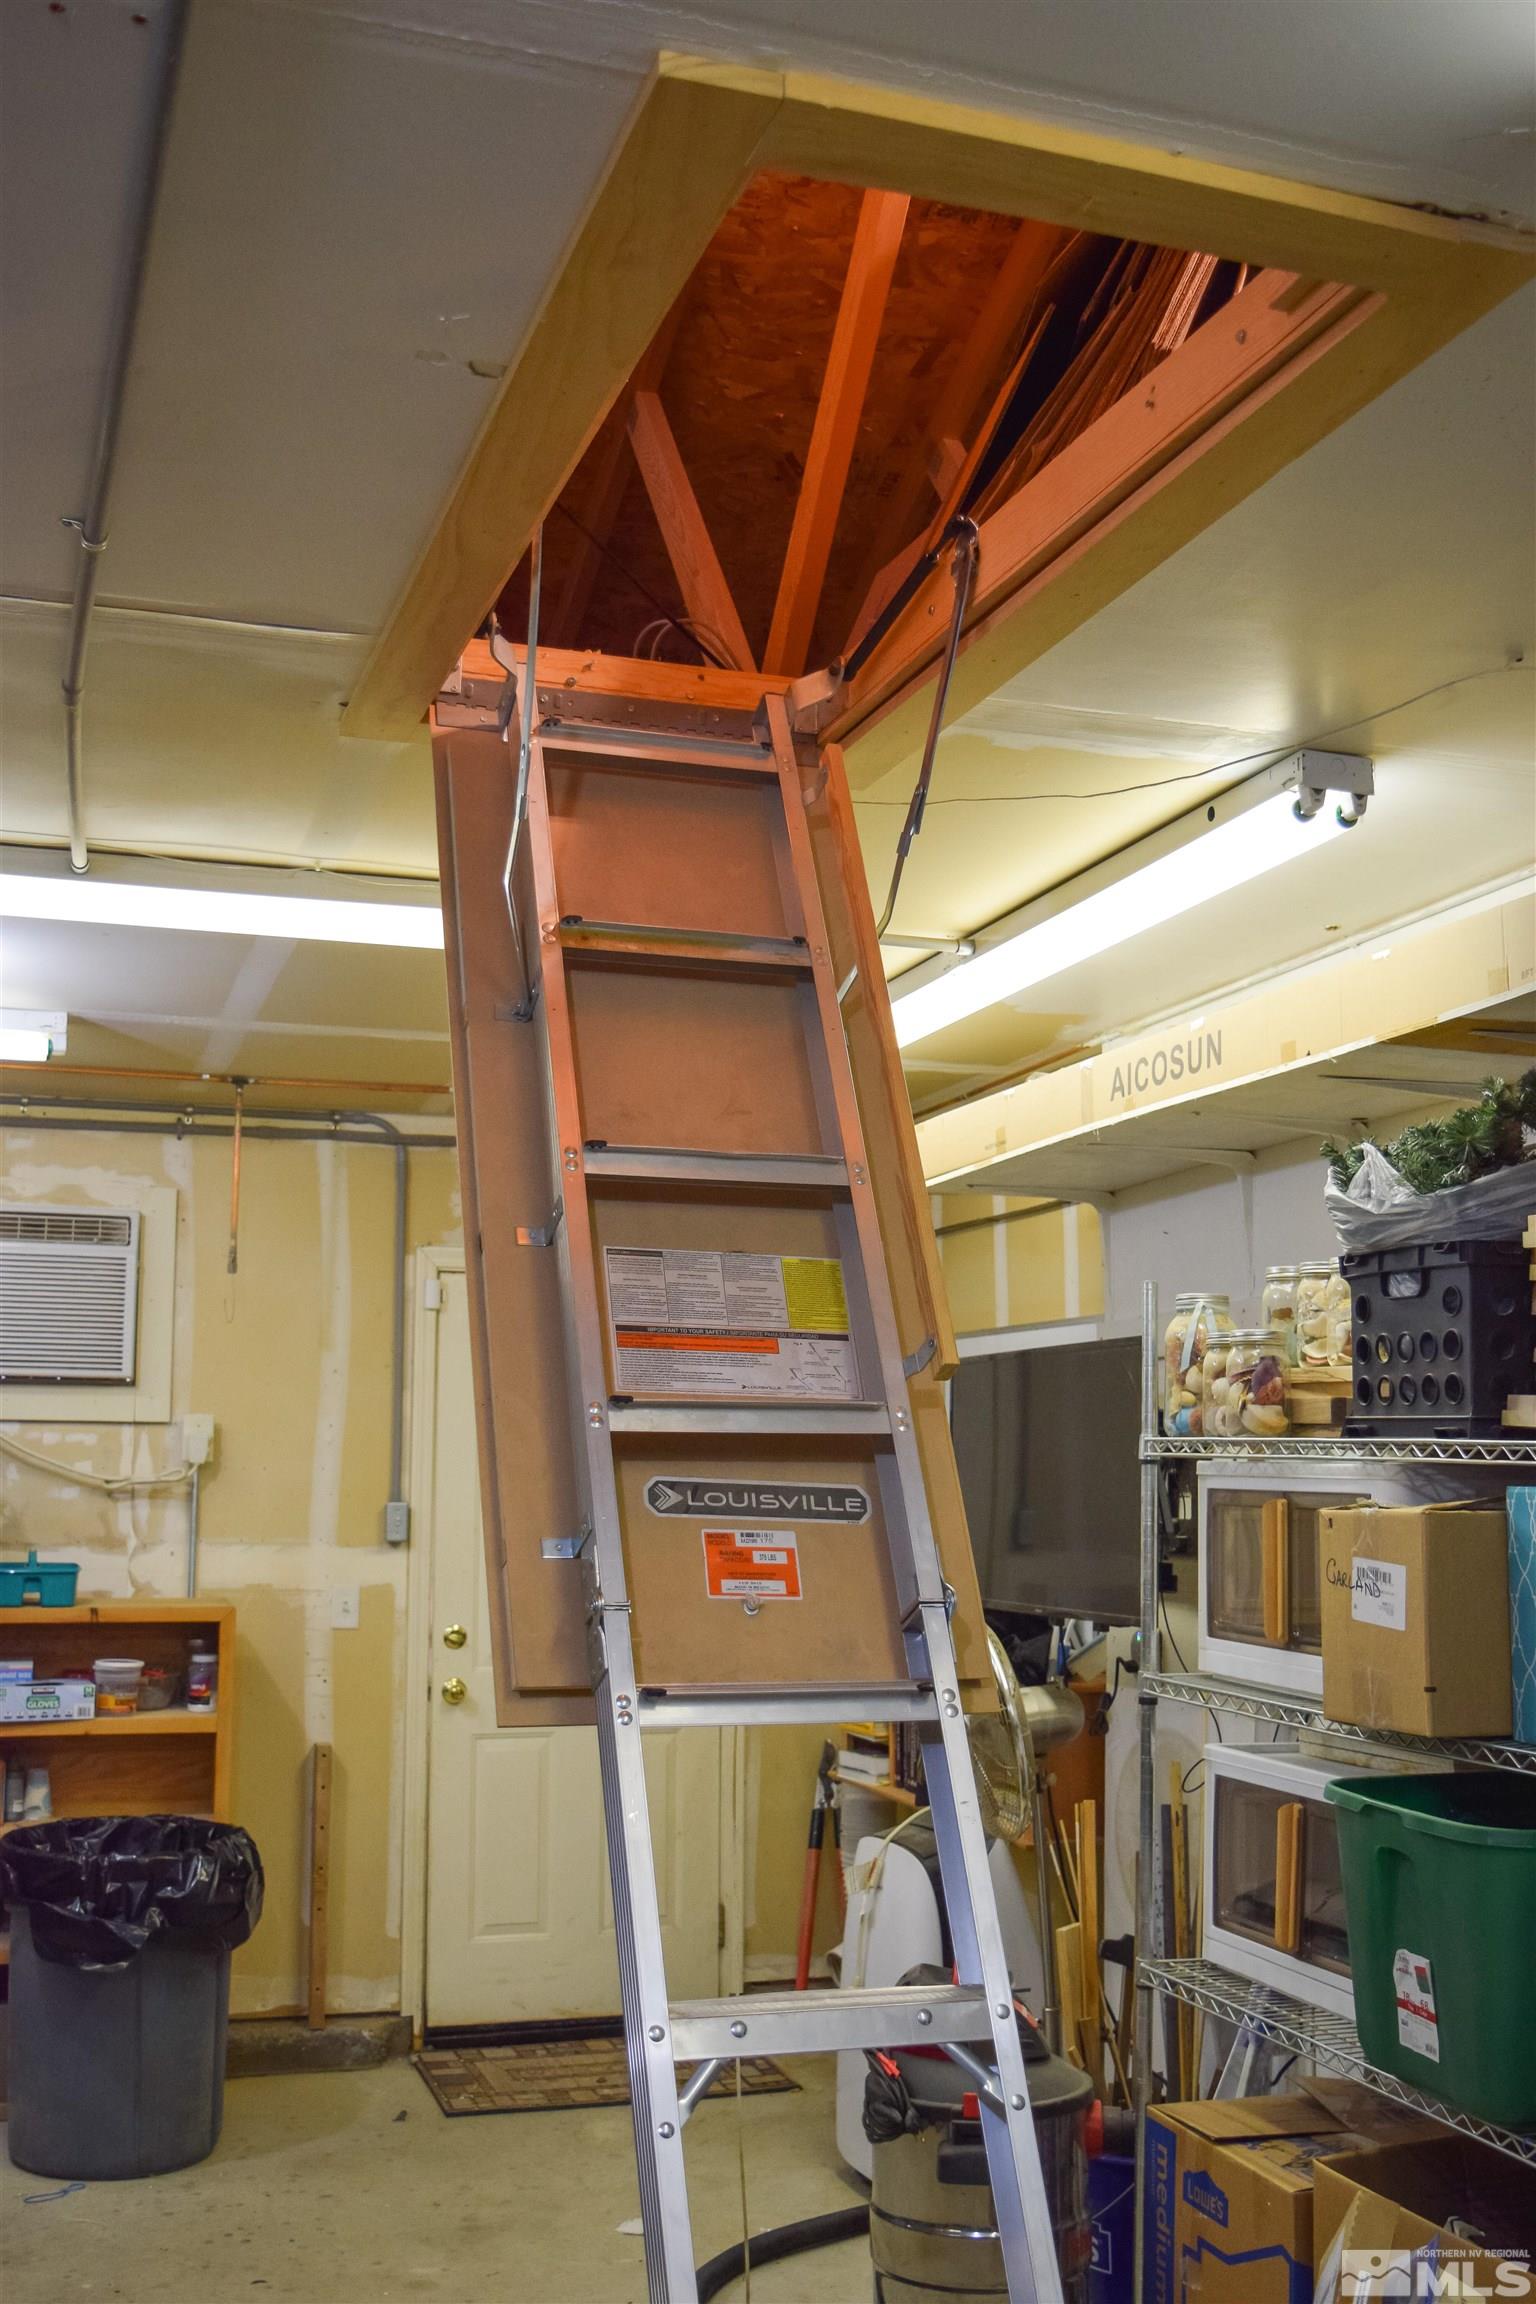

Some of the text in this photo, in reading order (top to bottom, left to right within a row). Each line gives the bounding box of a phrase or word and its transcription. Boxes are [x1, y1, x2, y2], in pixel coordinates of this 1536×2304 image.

[1110, 1029, 1222, 1102] AICOSUN
[686, 1489, 865, 1513] LOUISVILLE
[1326, 1558, 1381, 1598] GARLAND
[27, 1700, 59, 1708] GLOVES
